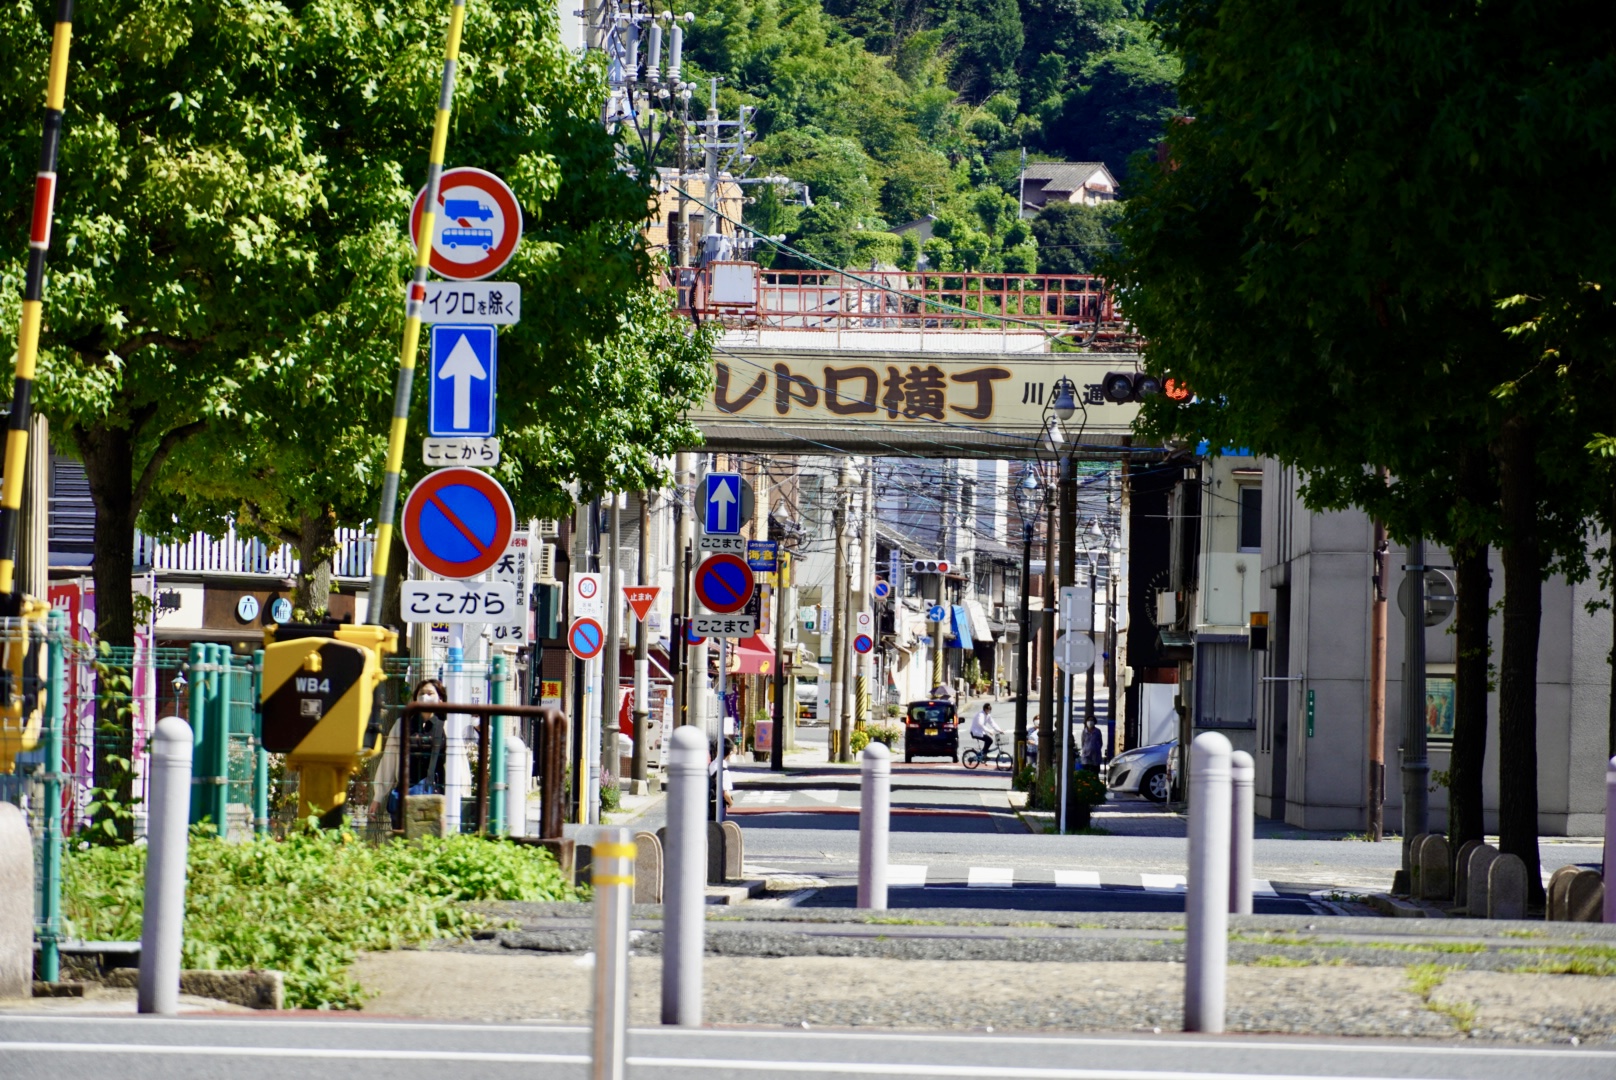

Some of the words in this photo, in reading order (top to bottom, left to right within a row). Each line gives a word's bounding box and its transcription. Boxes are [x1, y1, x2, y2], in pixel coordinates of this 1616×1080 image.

[423, 290, 514, 316] イクロを除く
[714, 360, 1012, 421] レトロ横丁
[427, 443, 494, 461] ここから
[700, 537, 743, 549] ここまで
[582, 582, 594, 593] 30
[411, 591, 505, 615] ここから
[629, 592, 654, 602] 止まれ
[494, 625, 523, 639] ひろ
[697, 619, 750, 633] ここまで
[295, 677, 331, 693] WB4
